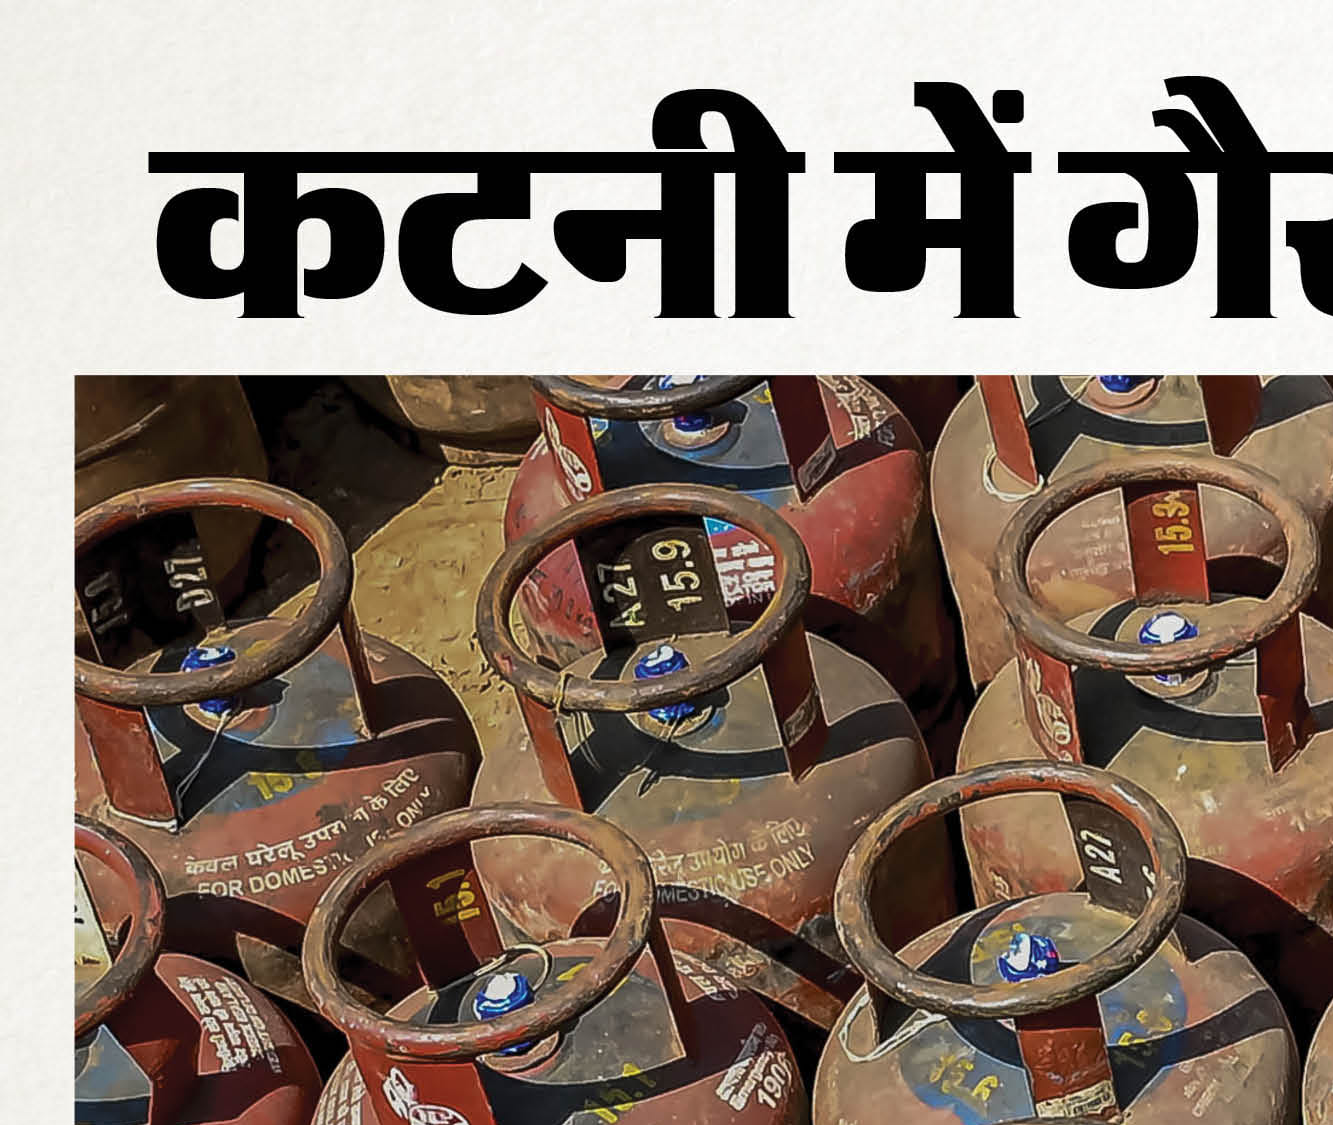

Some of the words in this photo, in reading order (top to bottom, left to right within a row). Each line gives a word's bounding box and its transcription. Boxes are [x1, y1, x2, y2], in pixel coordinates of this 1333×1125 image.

[598, 561, 646, 628] A27
[651, 539, 703, 612] 15.9
[243, 840, 305, 868] घरेलू
[384, 767, 421, 798] लिए
[198, 872, 244, 898] FOR
[592, 879, 622, 902] FO
[656, 872, 735, 905] MESTIC
[731, 861, 774, 892] USE
[768, 842, 816, 880] ONLY
[1080, 830, 1123, 885] A27
